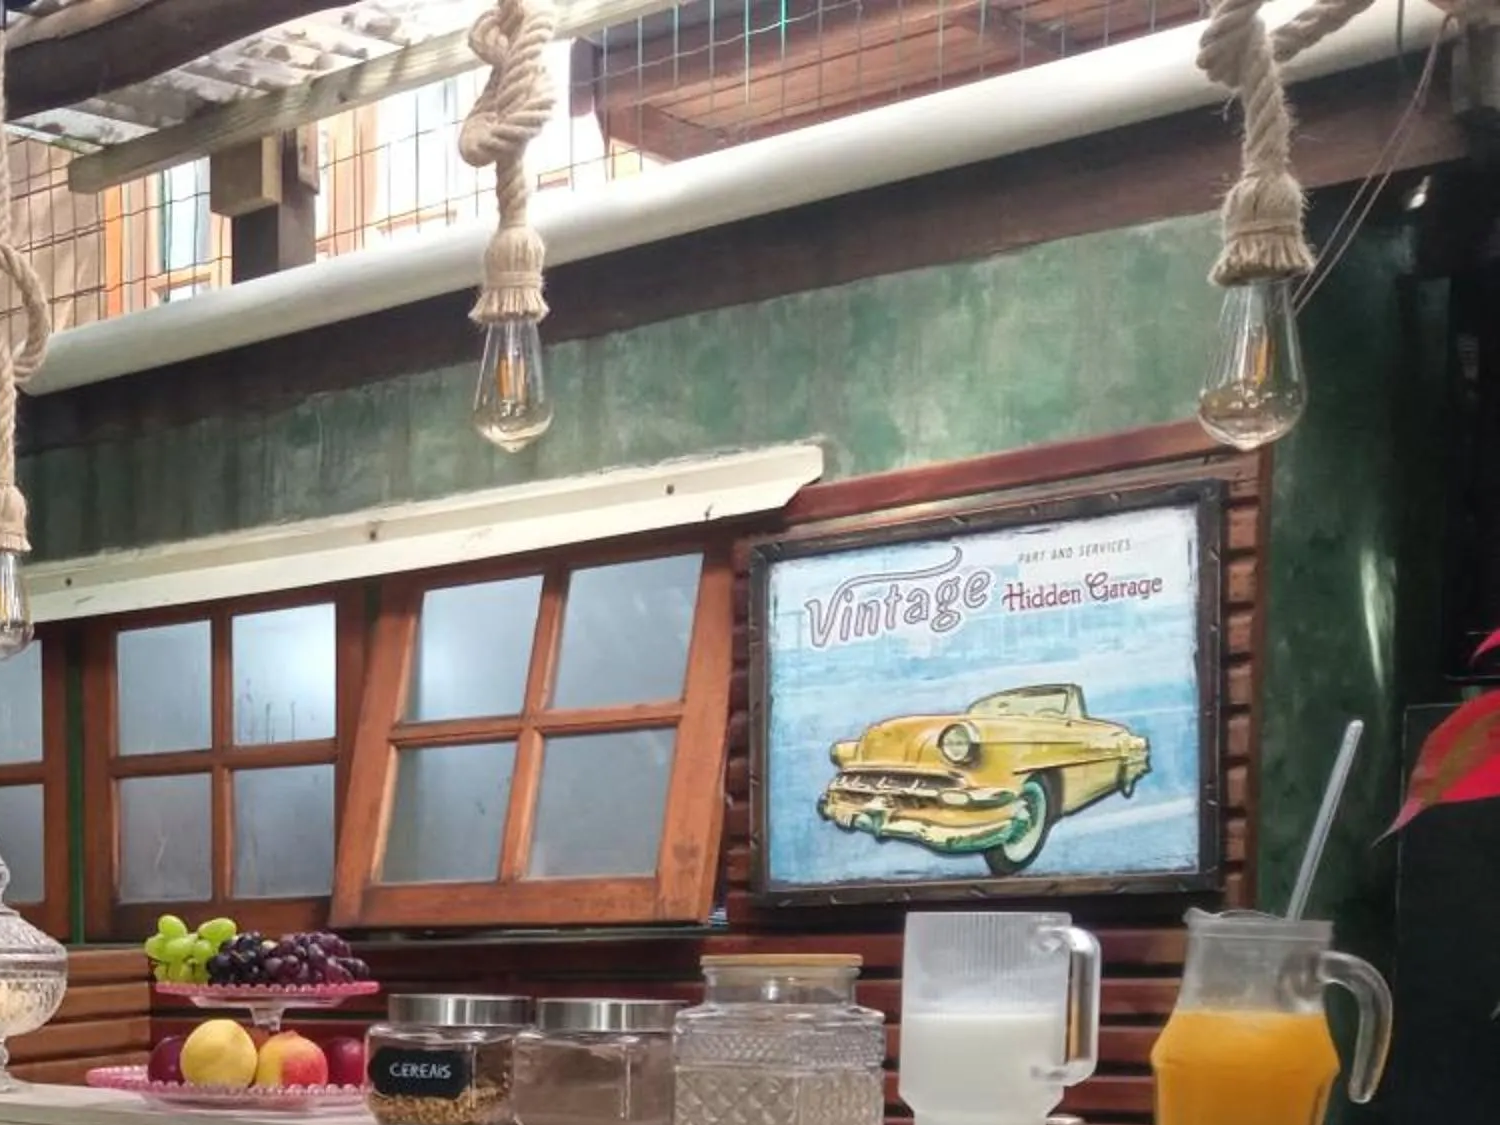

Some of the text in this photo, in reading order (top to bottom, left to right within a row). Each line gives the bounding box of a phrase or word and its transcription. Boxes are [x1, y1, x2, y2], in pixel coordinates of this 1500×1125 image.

[1018, 539, 1131, 564] PART AND SERVICES
[804, 546, 991, 647] Vintage
[1002, 572, 1163, 611] Hidden Garage
